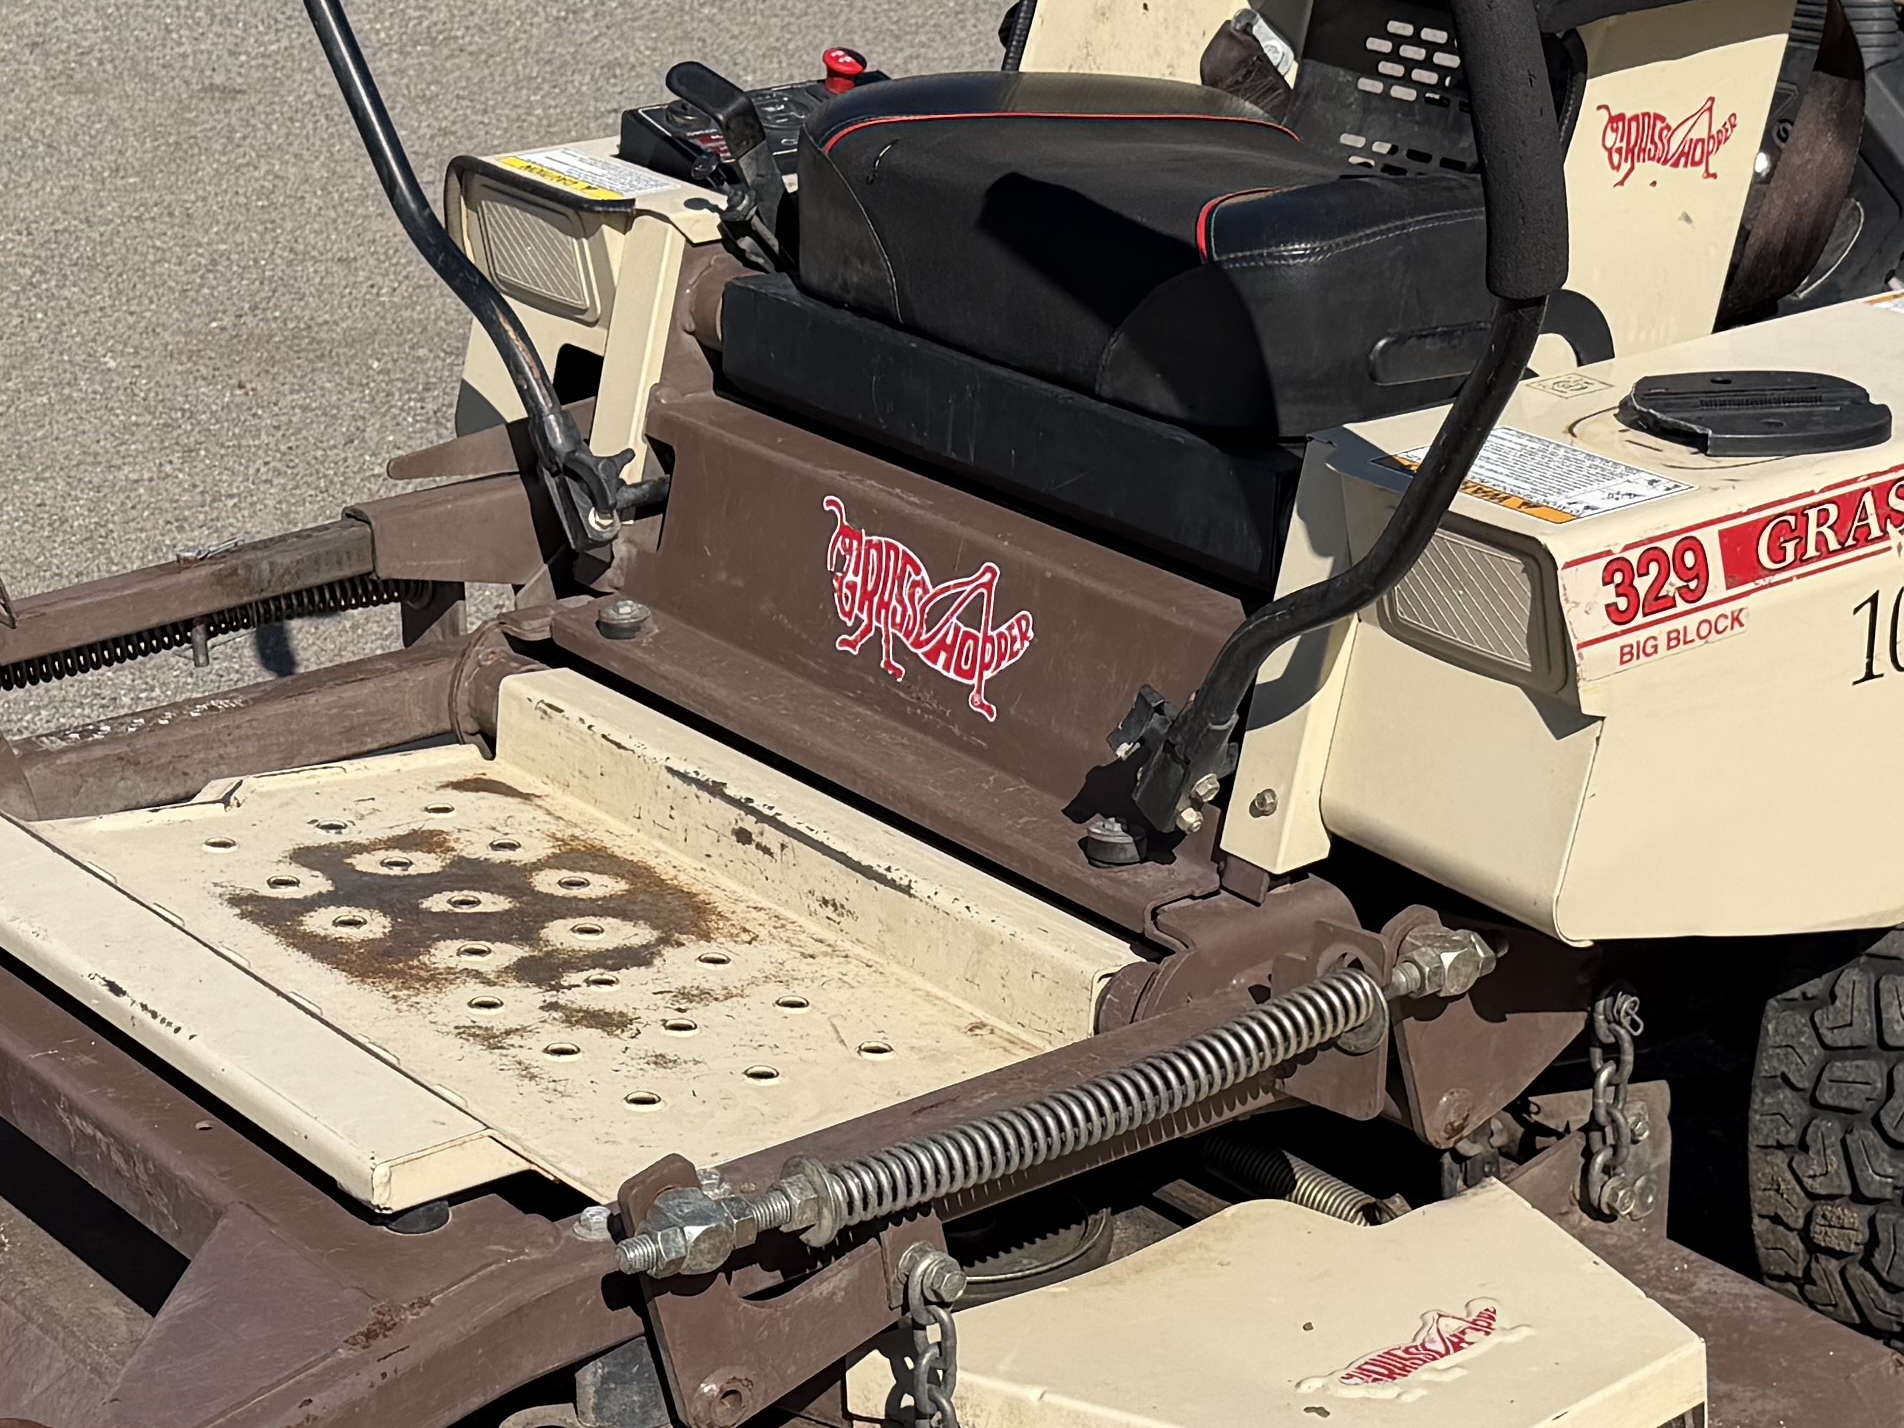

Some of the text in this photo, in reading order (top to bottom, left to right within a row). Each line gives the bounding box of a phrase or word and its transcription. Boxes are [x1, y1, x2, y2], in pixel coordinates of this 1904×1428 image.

[1598, 98, 1738, 181] GRASSHOPPER
[1601, 535, 1710, 626] 329
[1619, 607, 1747, 666] BIG BLOCK
